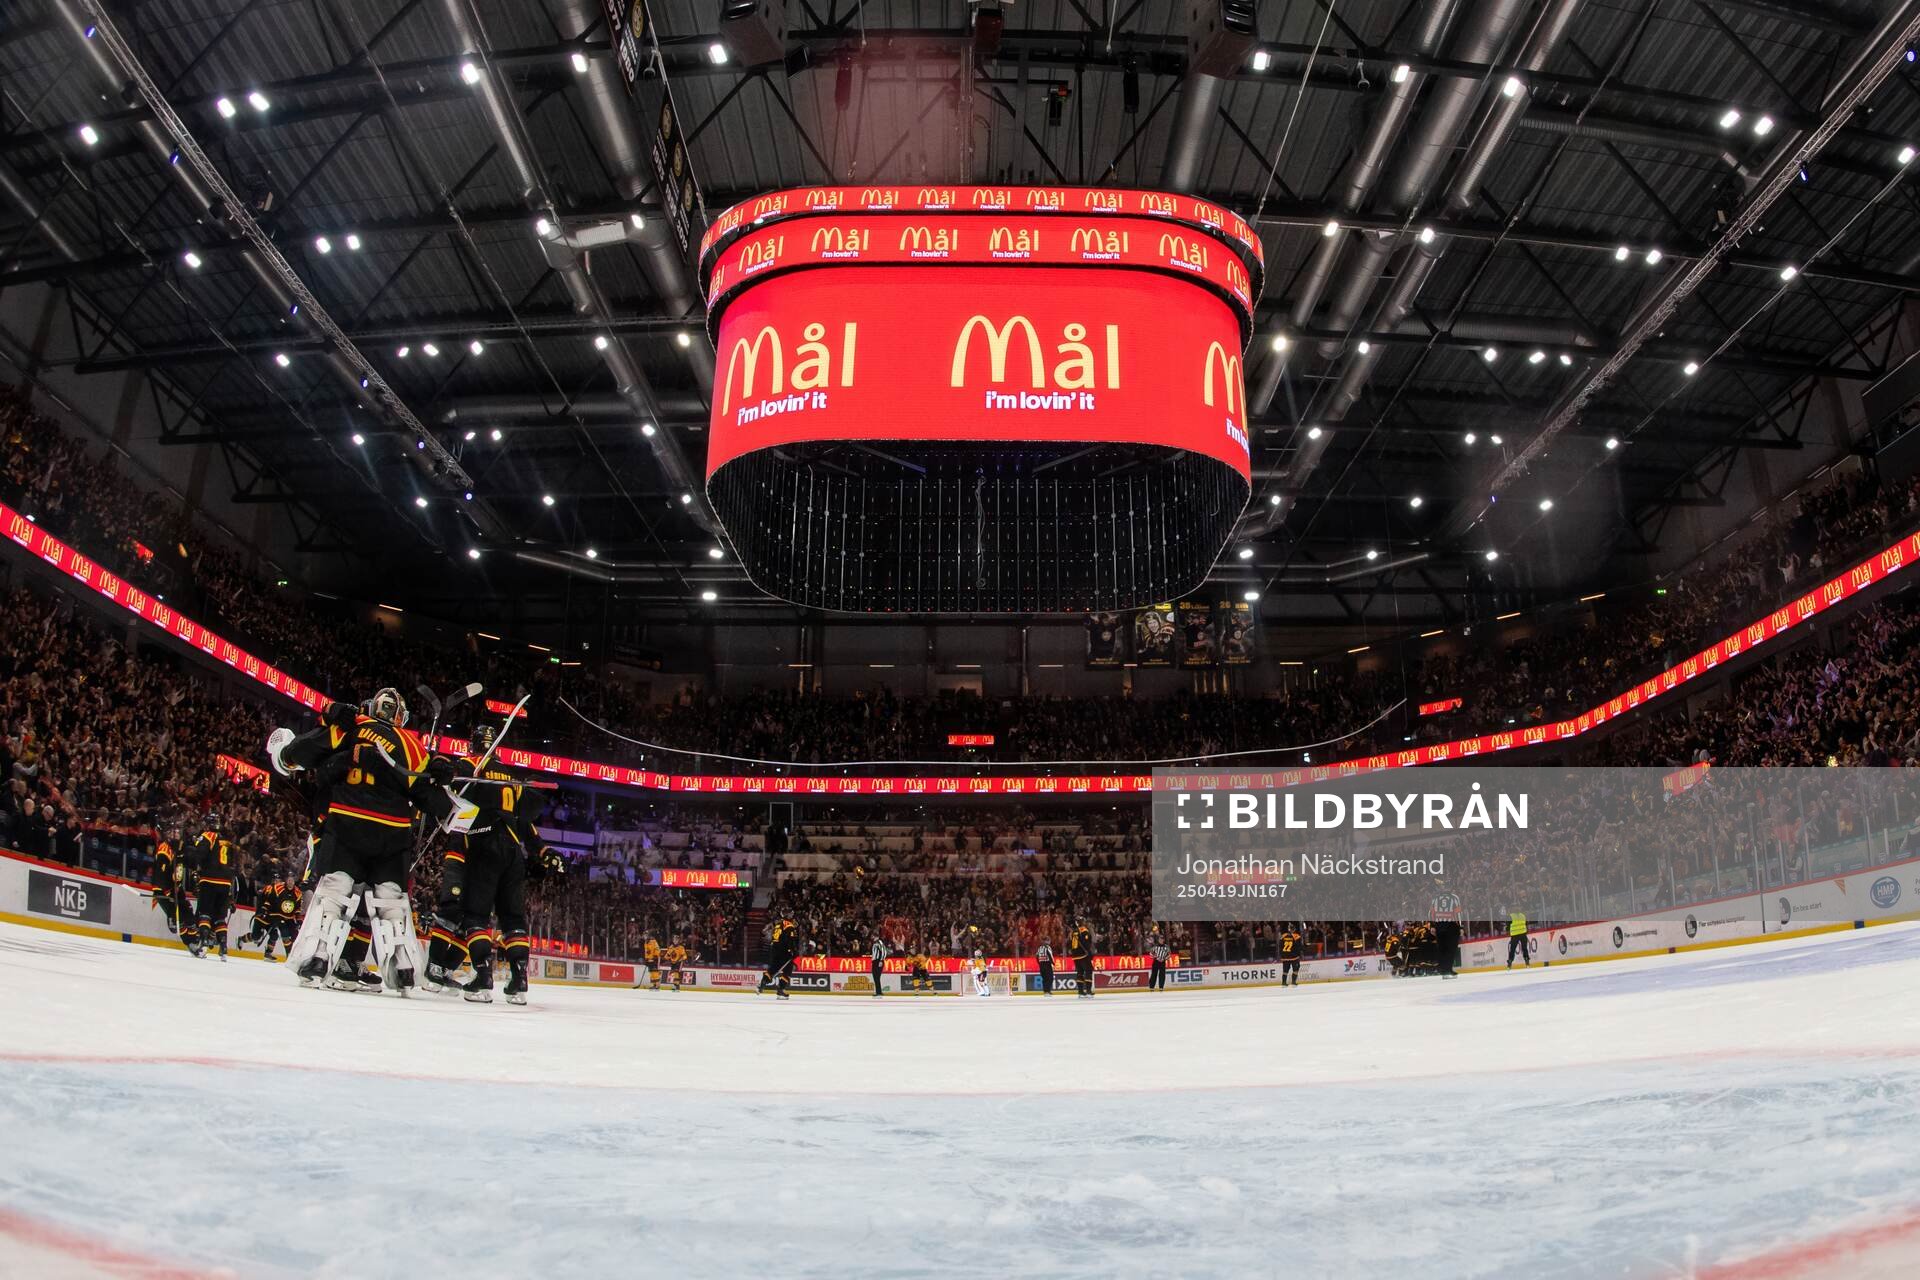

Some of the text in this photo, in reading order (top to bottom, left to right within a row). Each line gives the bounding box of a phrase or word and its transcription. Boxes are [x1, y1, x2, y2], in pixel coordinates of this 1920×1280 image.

[739, 235, 784, 272] Mål
[811, 227, 869, 252] Mål
[900, 227, 958, 250] Mål
[989, 227, 1039, 251] Mål
[1071, 228, 1128, 253] Mål
[1159, 233, 1208, 268] Mål
[951, 315, 1120, 389] Mål
[722, 322, 857, 416] Mål
[737, 391, 828, 426] i'm lovin' it
[985, 391, 1095, 410] i'm lovin' it
[9, 515, 33, 543] Mål
[41, 536, 63, 562] Mål
[71, 555, 92, 580] Mål
[99, 571, 119, 596] Mål
[126, 588, 146, 611] Mål
[151, 602, 170, 625] Mål
[176, 617, 194, 638] Mål
[1724, 635, 1742, 655] Mål
[1747, 623, 1765, 643] Mål
[1771, 608, 1790, 631] Mål
[1796, 595, 1817, 617] Mål
[1823, 579, 1844, 603] Mål
[1851, 562, 1873, 587] Mål
[1881, 545, 1904, 571] Mål
[686, 871, 709, 884] Mål
[54, 886, 88, 912] NKB
[1877, 885, 1895, 897] HMP
[801, 957, 826, 972] Mål
[840, 958, 866, 973] Mål
[1165, 970, 1203, 983] TSG
[1222, 969, 1276, 981] THORNE
